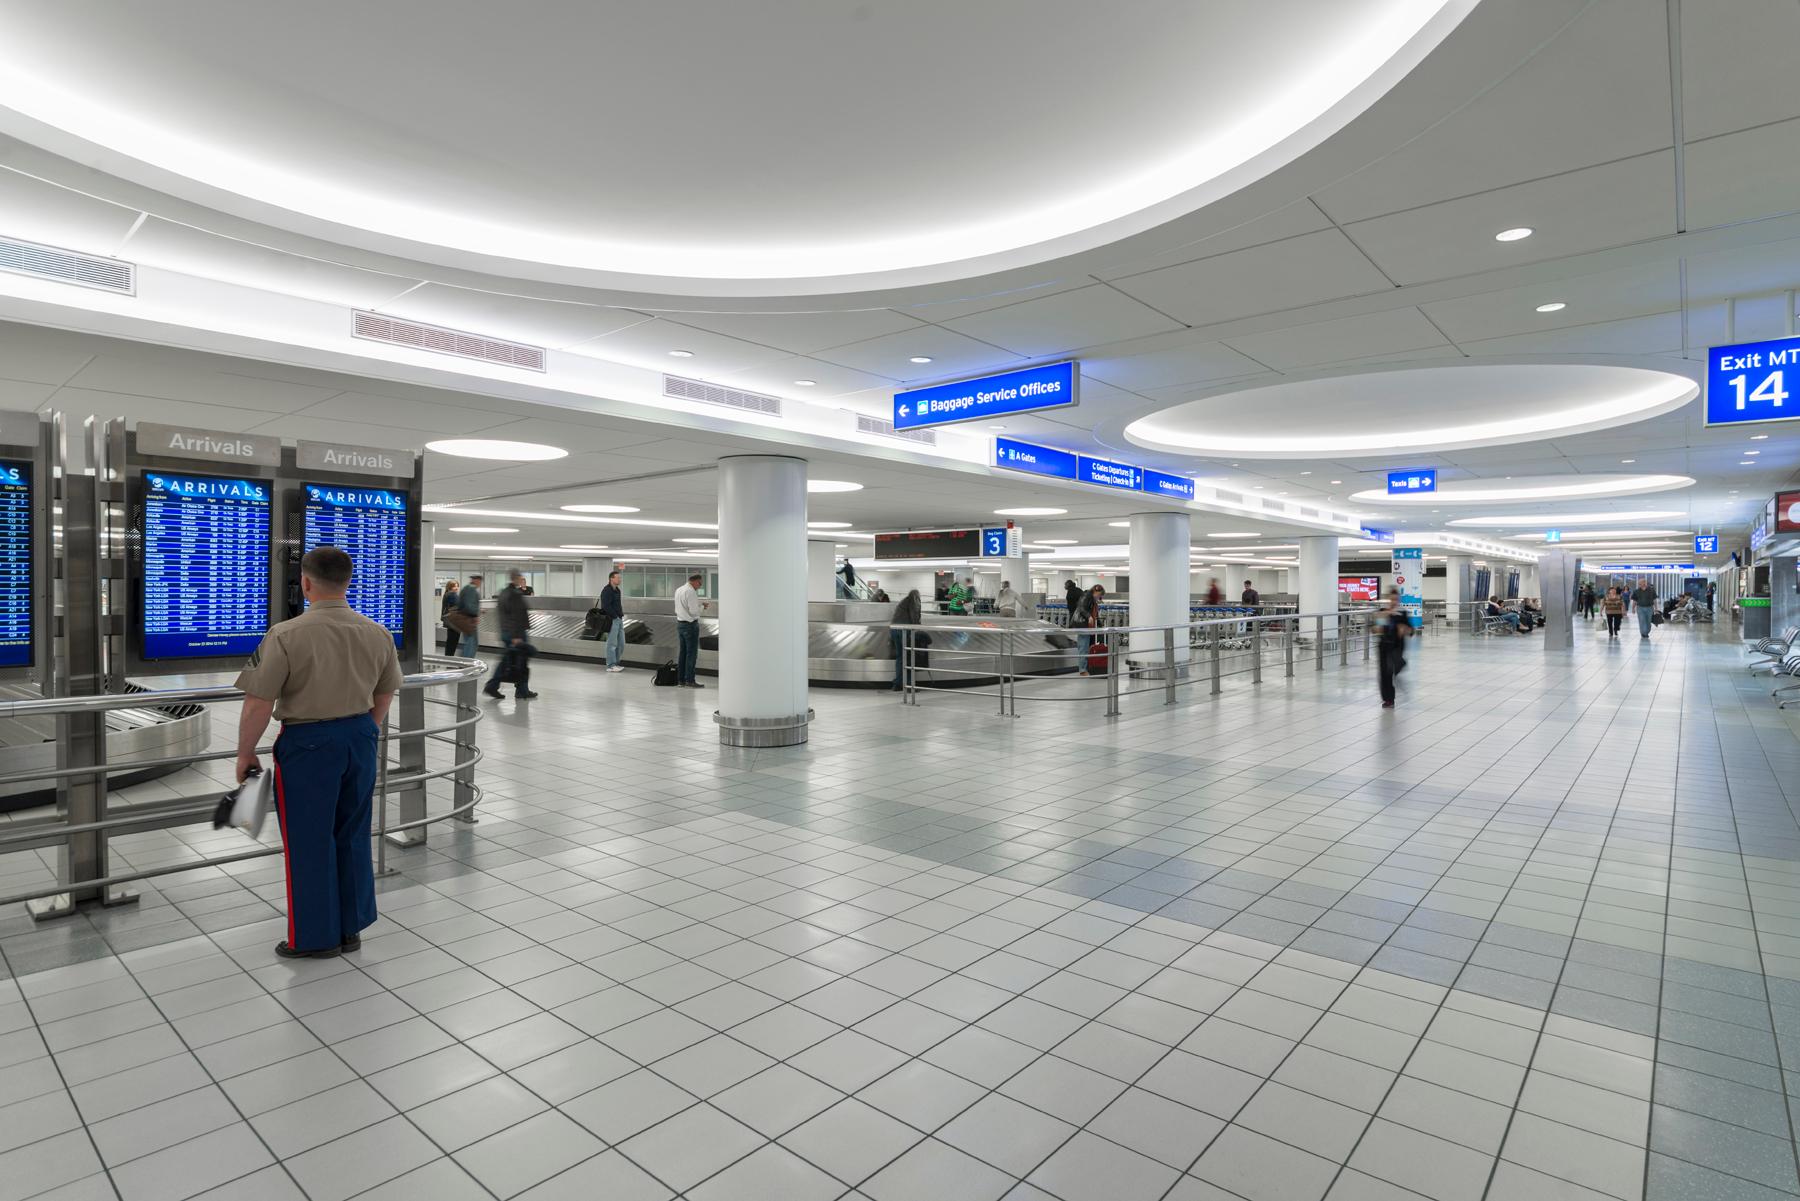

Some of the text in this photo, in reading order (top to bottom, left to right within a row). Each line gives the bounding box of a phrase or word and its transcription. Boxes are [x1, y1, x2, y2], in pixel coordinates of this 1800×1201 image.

[1721, 352, 1762, 371] Exit
[930, 382, 1061, 412] Baggage Service Offices
[1728, 370, 1789, 410] 14
[168, 433, 254, 457] Arrivals
[323, 449, 393, 469] Arrivals
[1015, 452, 1036, 463] A Gates
[1091, 472, 1110, 484] Ticketing
[1096, 463, 1109, 473] Gates
[1109, 466, 1129, 476] Departures
[169, 480, 263, 497] ARRIVALS
[325, 492, 401, 505] ARRIVALS
[990, 537, 1000, 555] 3
[1699, 542, 1712, 551] 12
